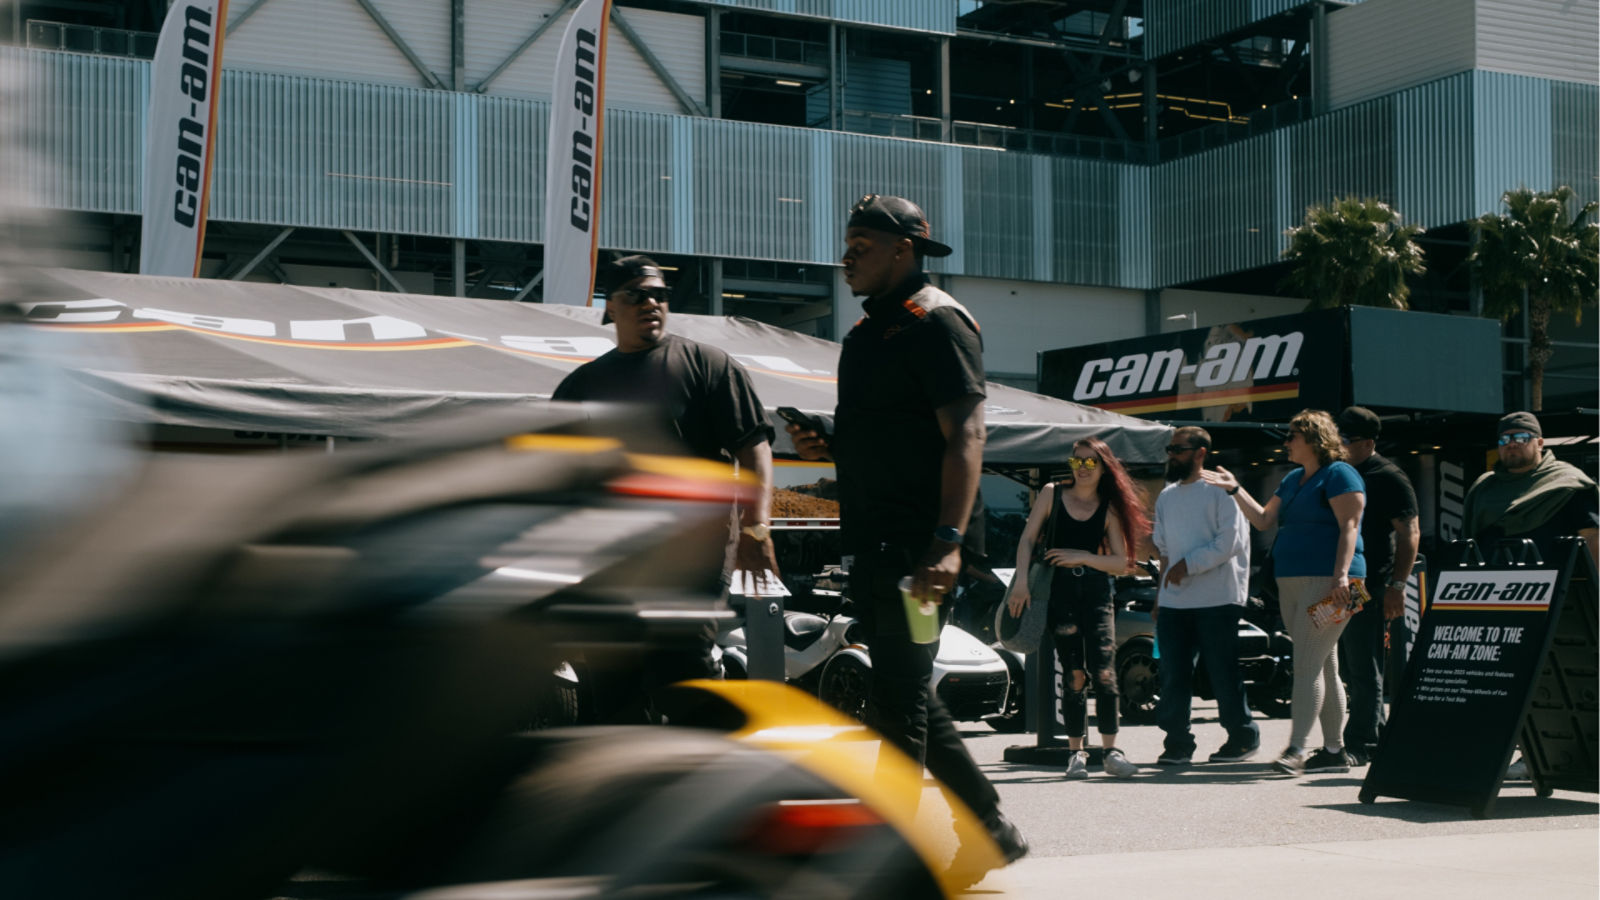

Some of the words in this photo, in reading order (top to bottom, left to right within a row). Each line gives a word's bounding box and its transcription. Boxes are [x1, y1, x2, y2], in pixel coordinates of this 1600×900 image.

[174, 5, 212, 229] can-am
[571, 28, 596, 233] can-am
[1073, 331, 1304, 401] can-am
[1439, 582, 1551, 601] can-am
[1427, 643, 1470, 660] CAN-AM
[1469, 646, 1502, 661] ZONE:
[1433, 626, 1484, 642] WELCOME
[1485, 627, 1501, 642] TO
[1502, 627, 1525, 643] THE
